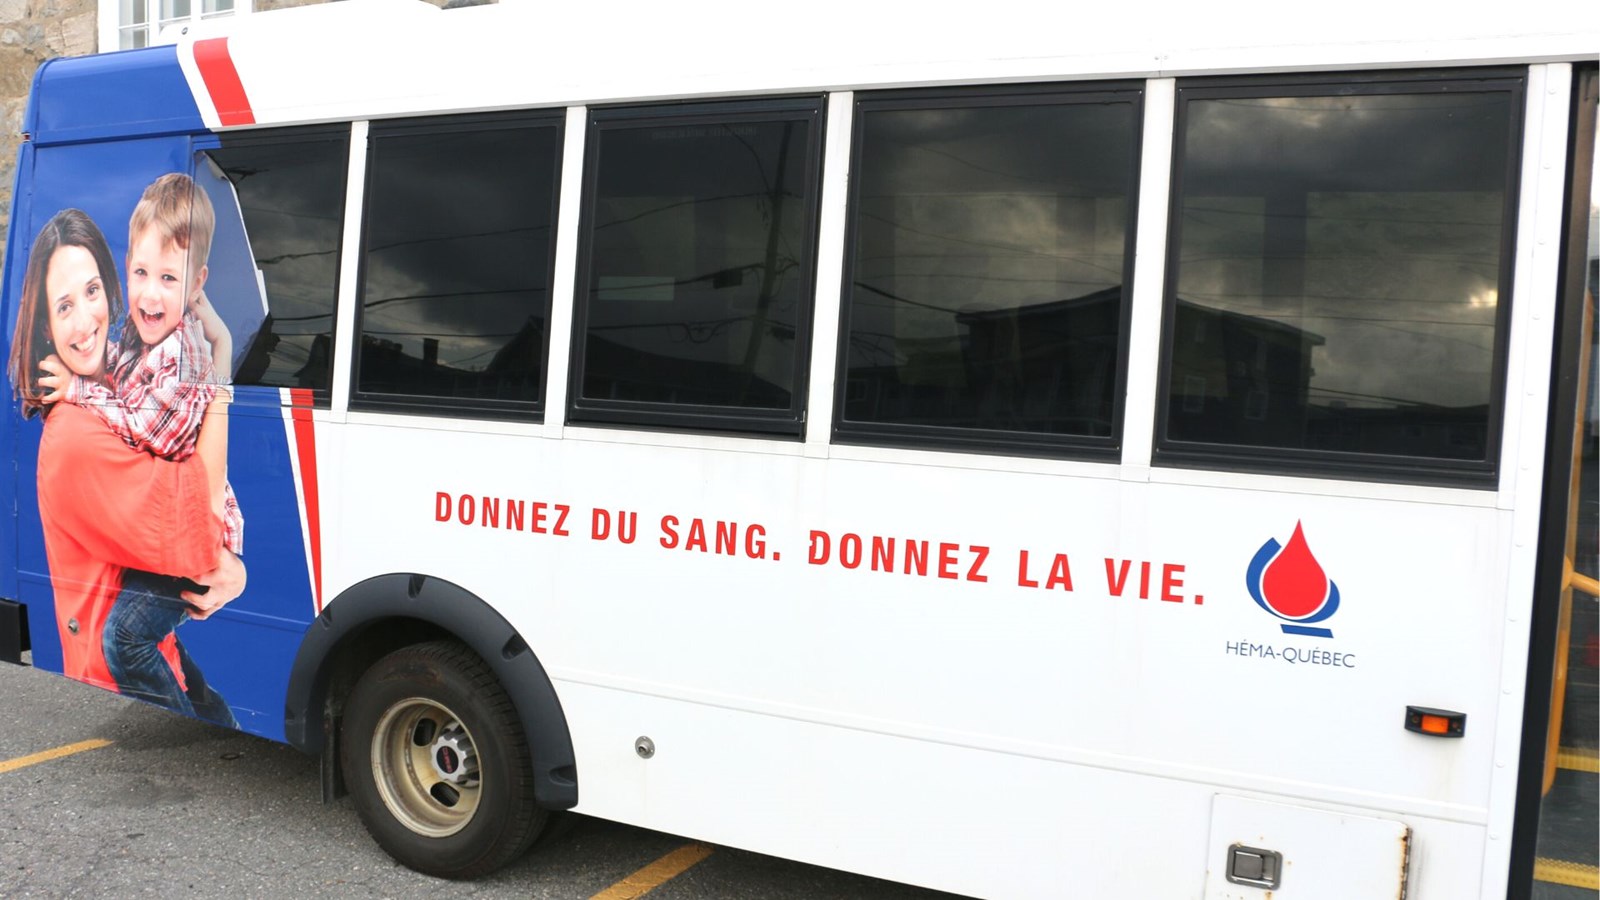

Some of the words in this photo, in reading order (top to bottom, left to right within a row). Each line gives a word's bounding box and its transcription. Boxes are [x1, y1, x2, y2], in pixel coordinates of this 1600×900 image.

[434, 491, 571, 537] DONNEZ
[591, 507, 638, 545] DU
[659, 514, 781, 561] SANG.
[807, 529, 991, 583] DONNEZ
[1017, 549, 1074, 593] LA
[1104, 557, 1205, 606] VIE.
[1226, 639, 1356, 668] HÉMA-QUÉBEC
